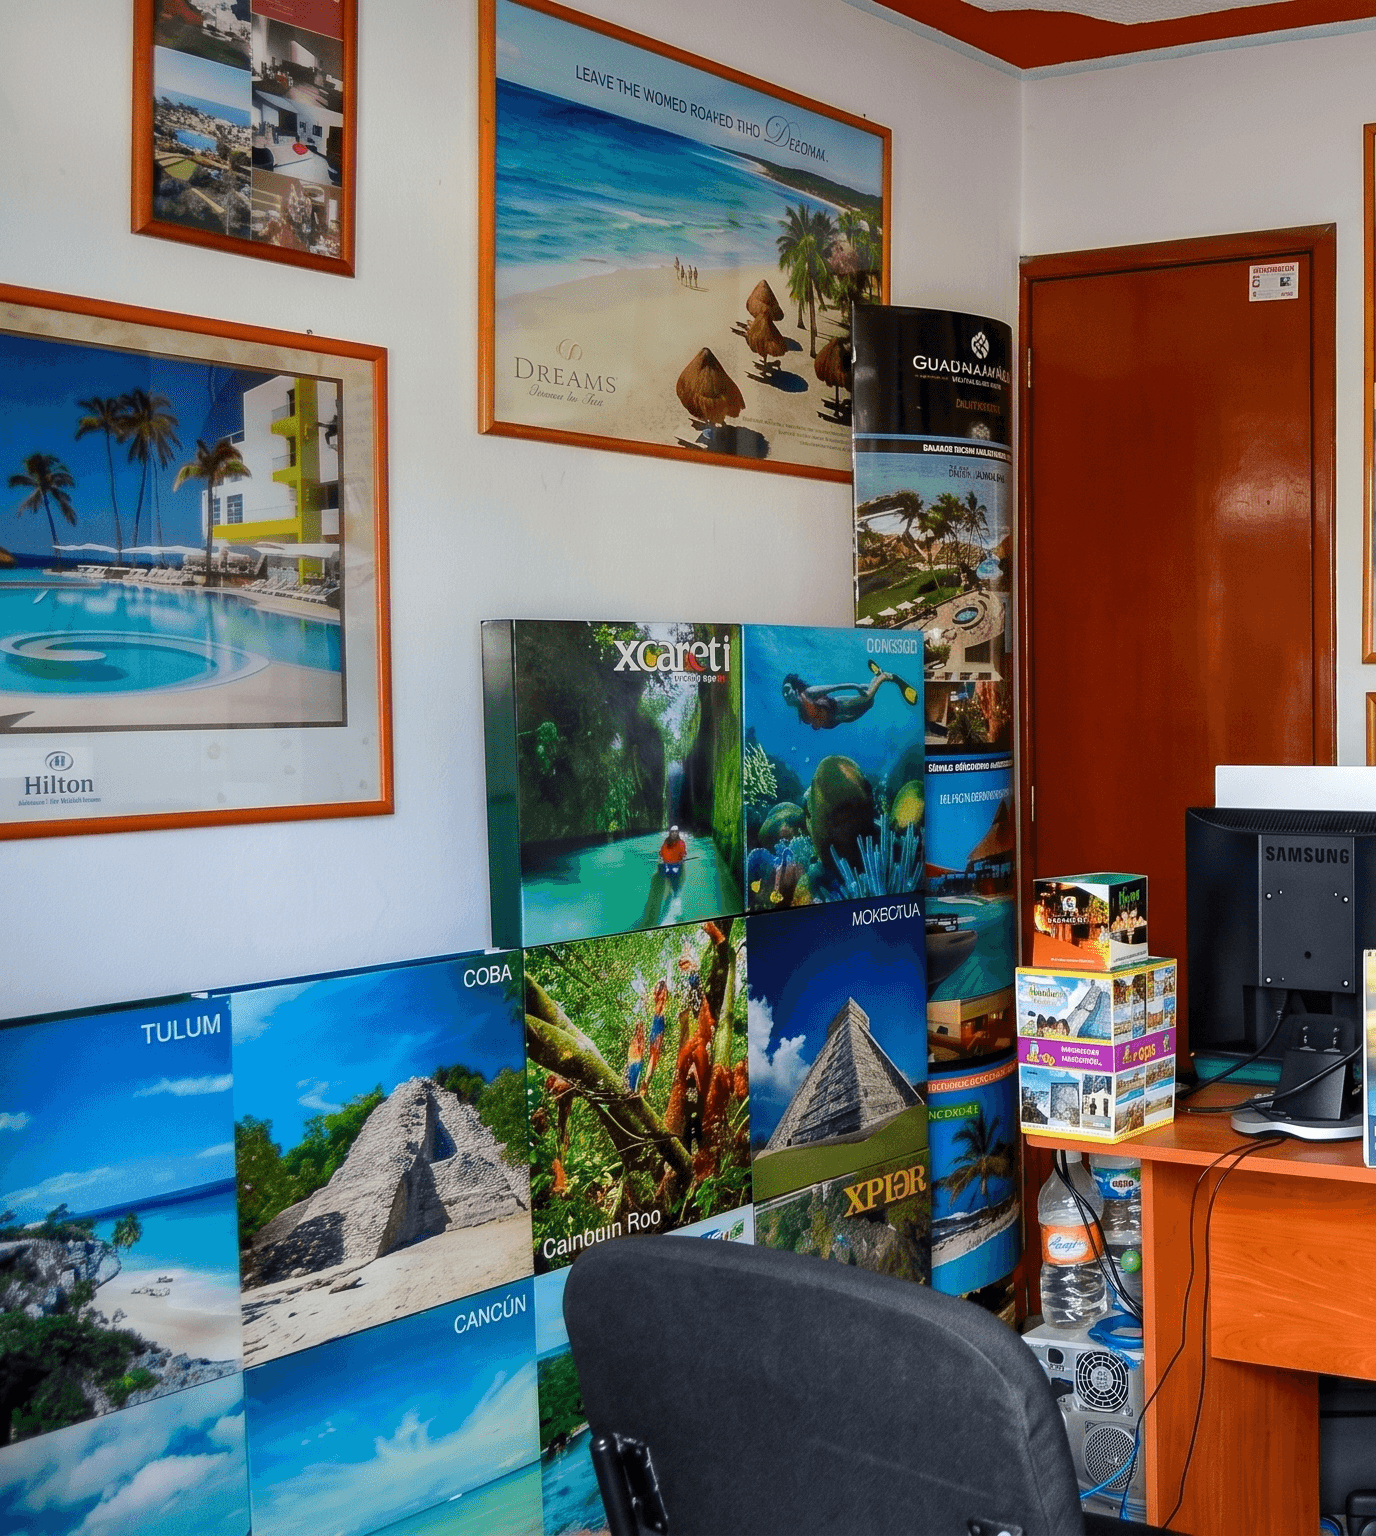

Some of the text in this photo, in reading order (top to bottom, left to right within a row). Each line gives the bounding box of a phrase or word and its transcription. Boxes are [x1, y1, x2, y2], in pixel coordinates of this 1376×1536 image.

[575, 64, 614, 91] LEAVE
[616, 78, 641, 99] THE
[643, 86, 687, 114] WOMED
[514, 356, 617, 394] DREAMS
[24, 774, 94, 796] Hilton
[1265, 845, 1350, 865] SAMSUNG
[463, 963, 513, 989] COBA
[140, 1013, 221, 1044] TULUM
[627, 1209, 662, 1232] Roo
[454, 1294, 527, 1334] CANCÚN
